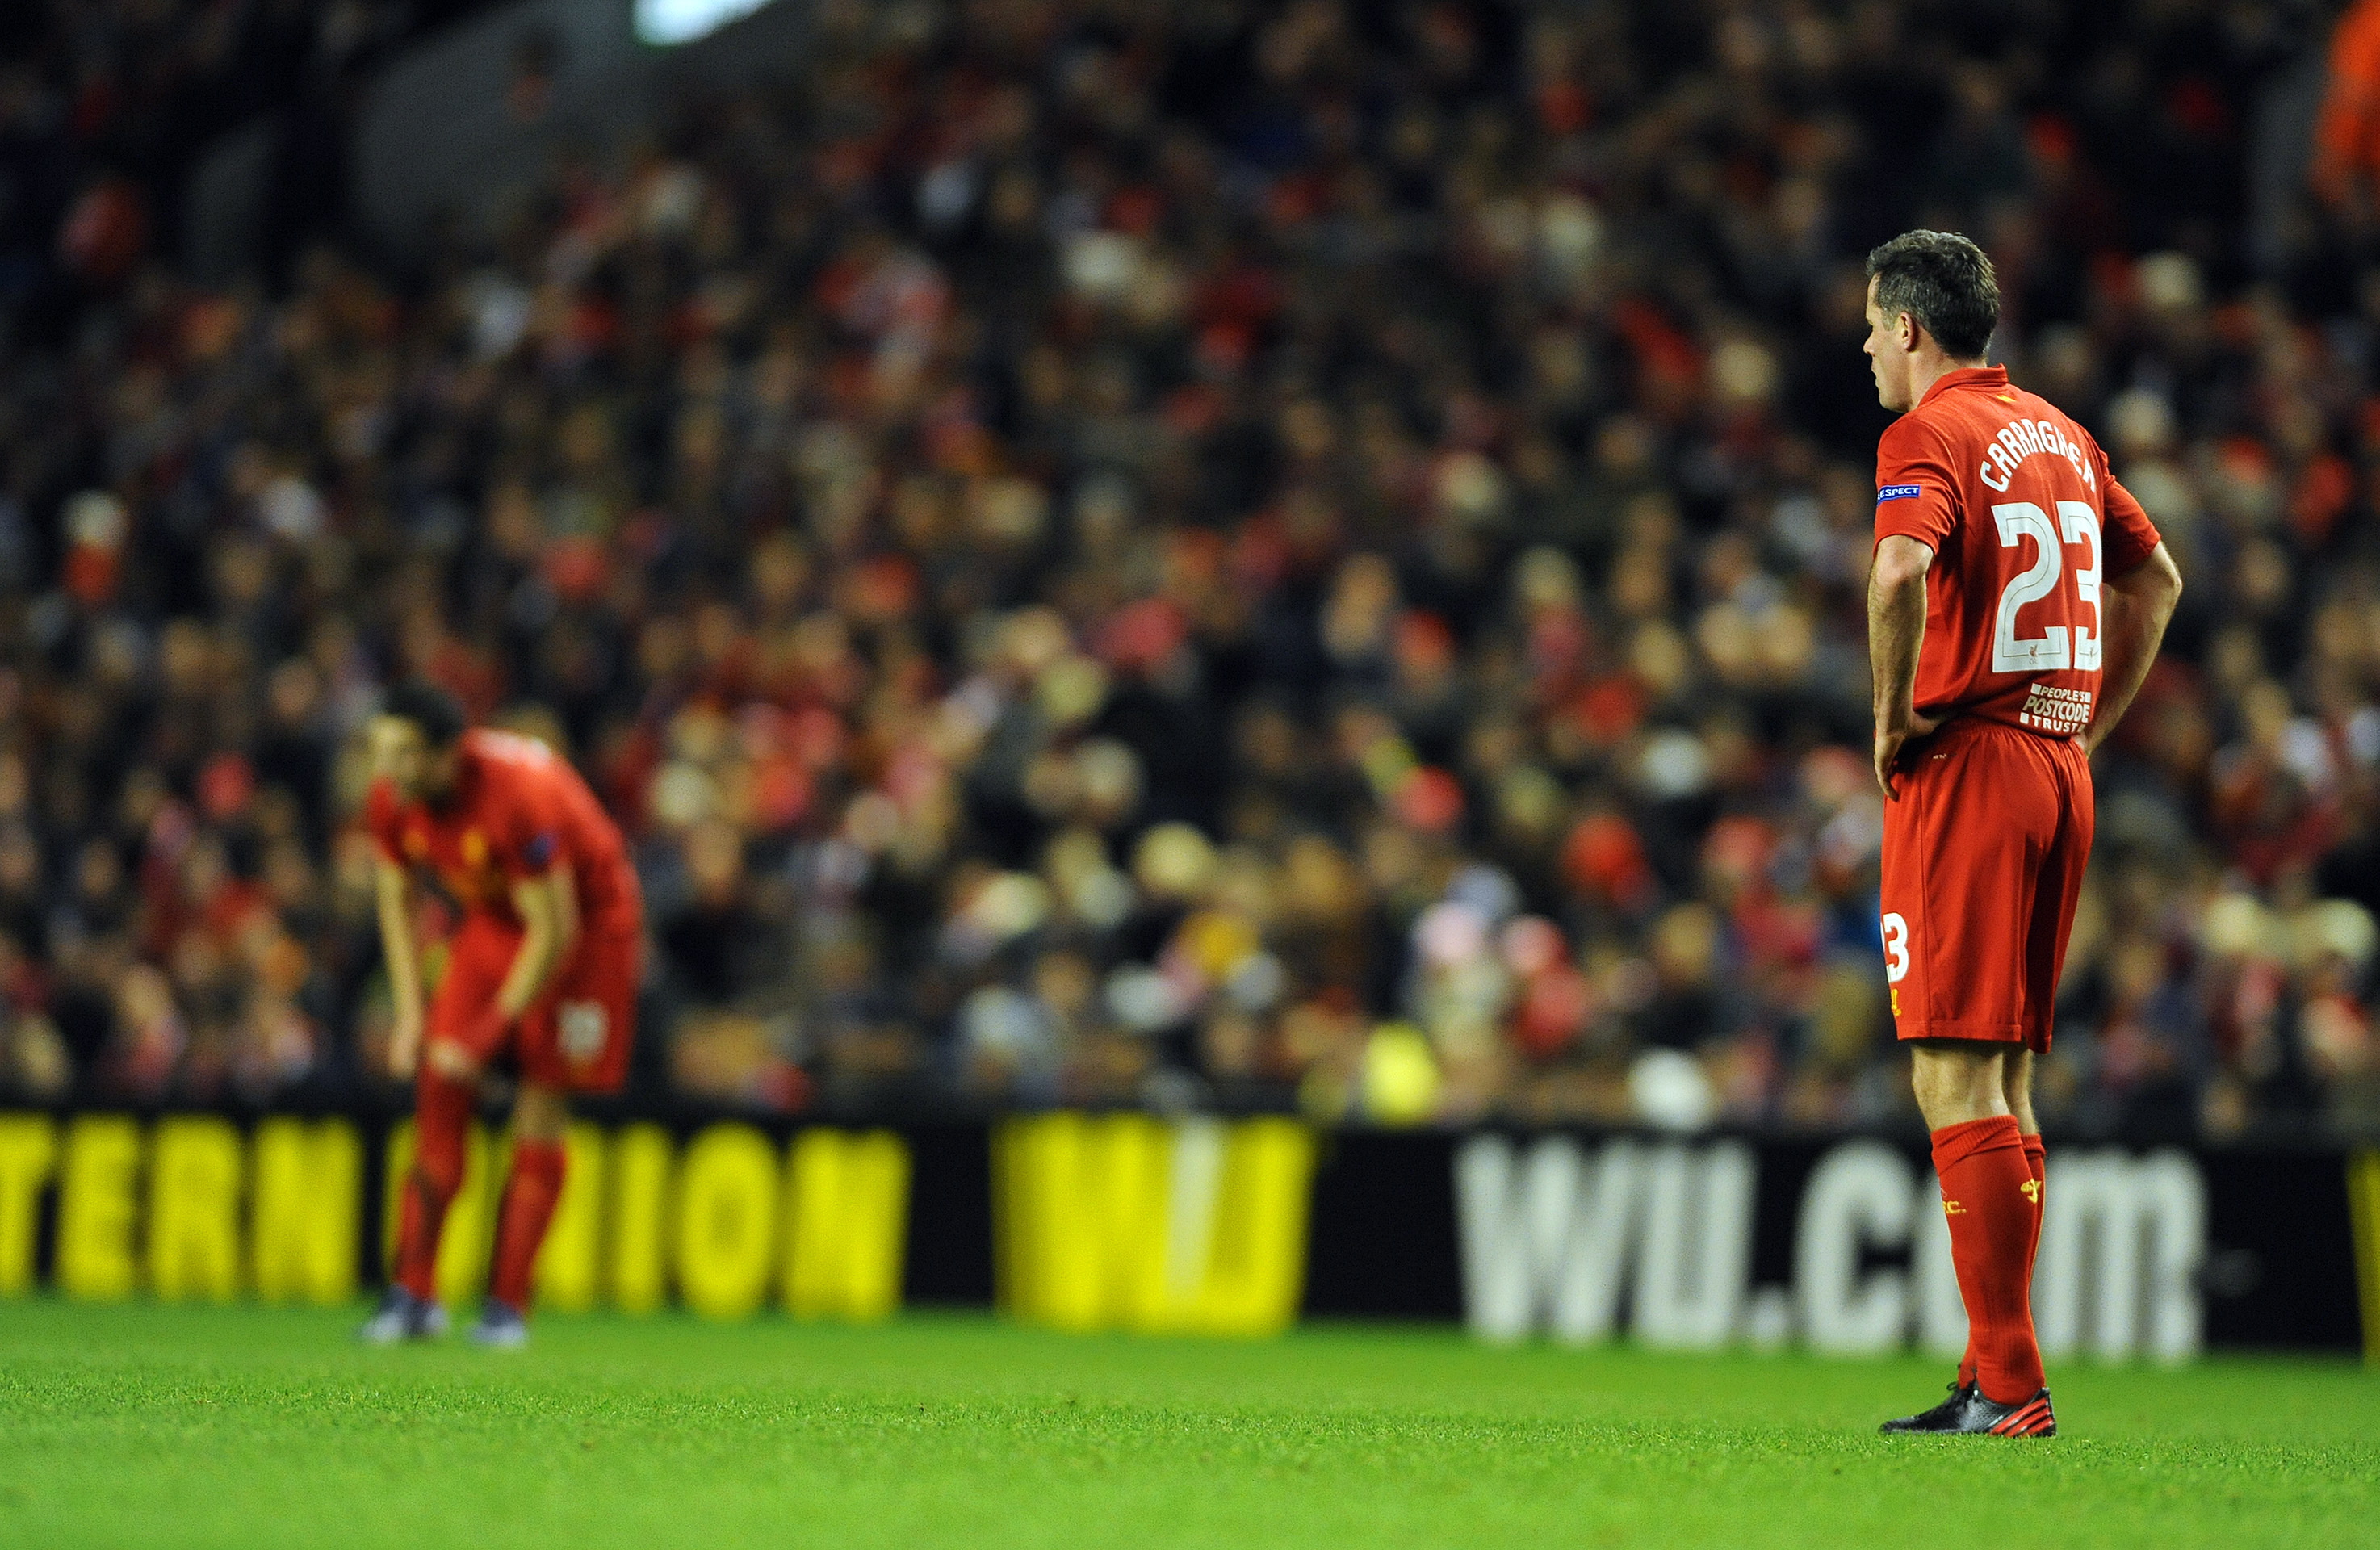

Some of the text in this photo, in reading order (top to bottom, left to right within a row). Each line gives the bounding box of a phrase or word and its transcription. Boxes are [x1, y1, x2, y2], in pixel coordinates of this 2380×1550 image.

[1980, 418, 2096, 492] CARRAGHER
[1878, 487, 1919, 500] ESPECT
[1991, 501, 2102, 673] 23
[2040, 686, 2085, 702] PEOPLE'S
[2022, 695, 2090, 723] POSTCODE
[2032, 714, 2078, 733] TRUST
[1880, 912, 1909, 982] 3
